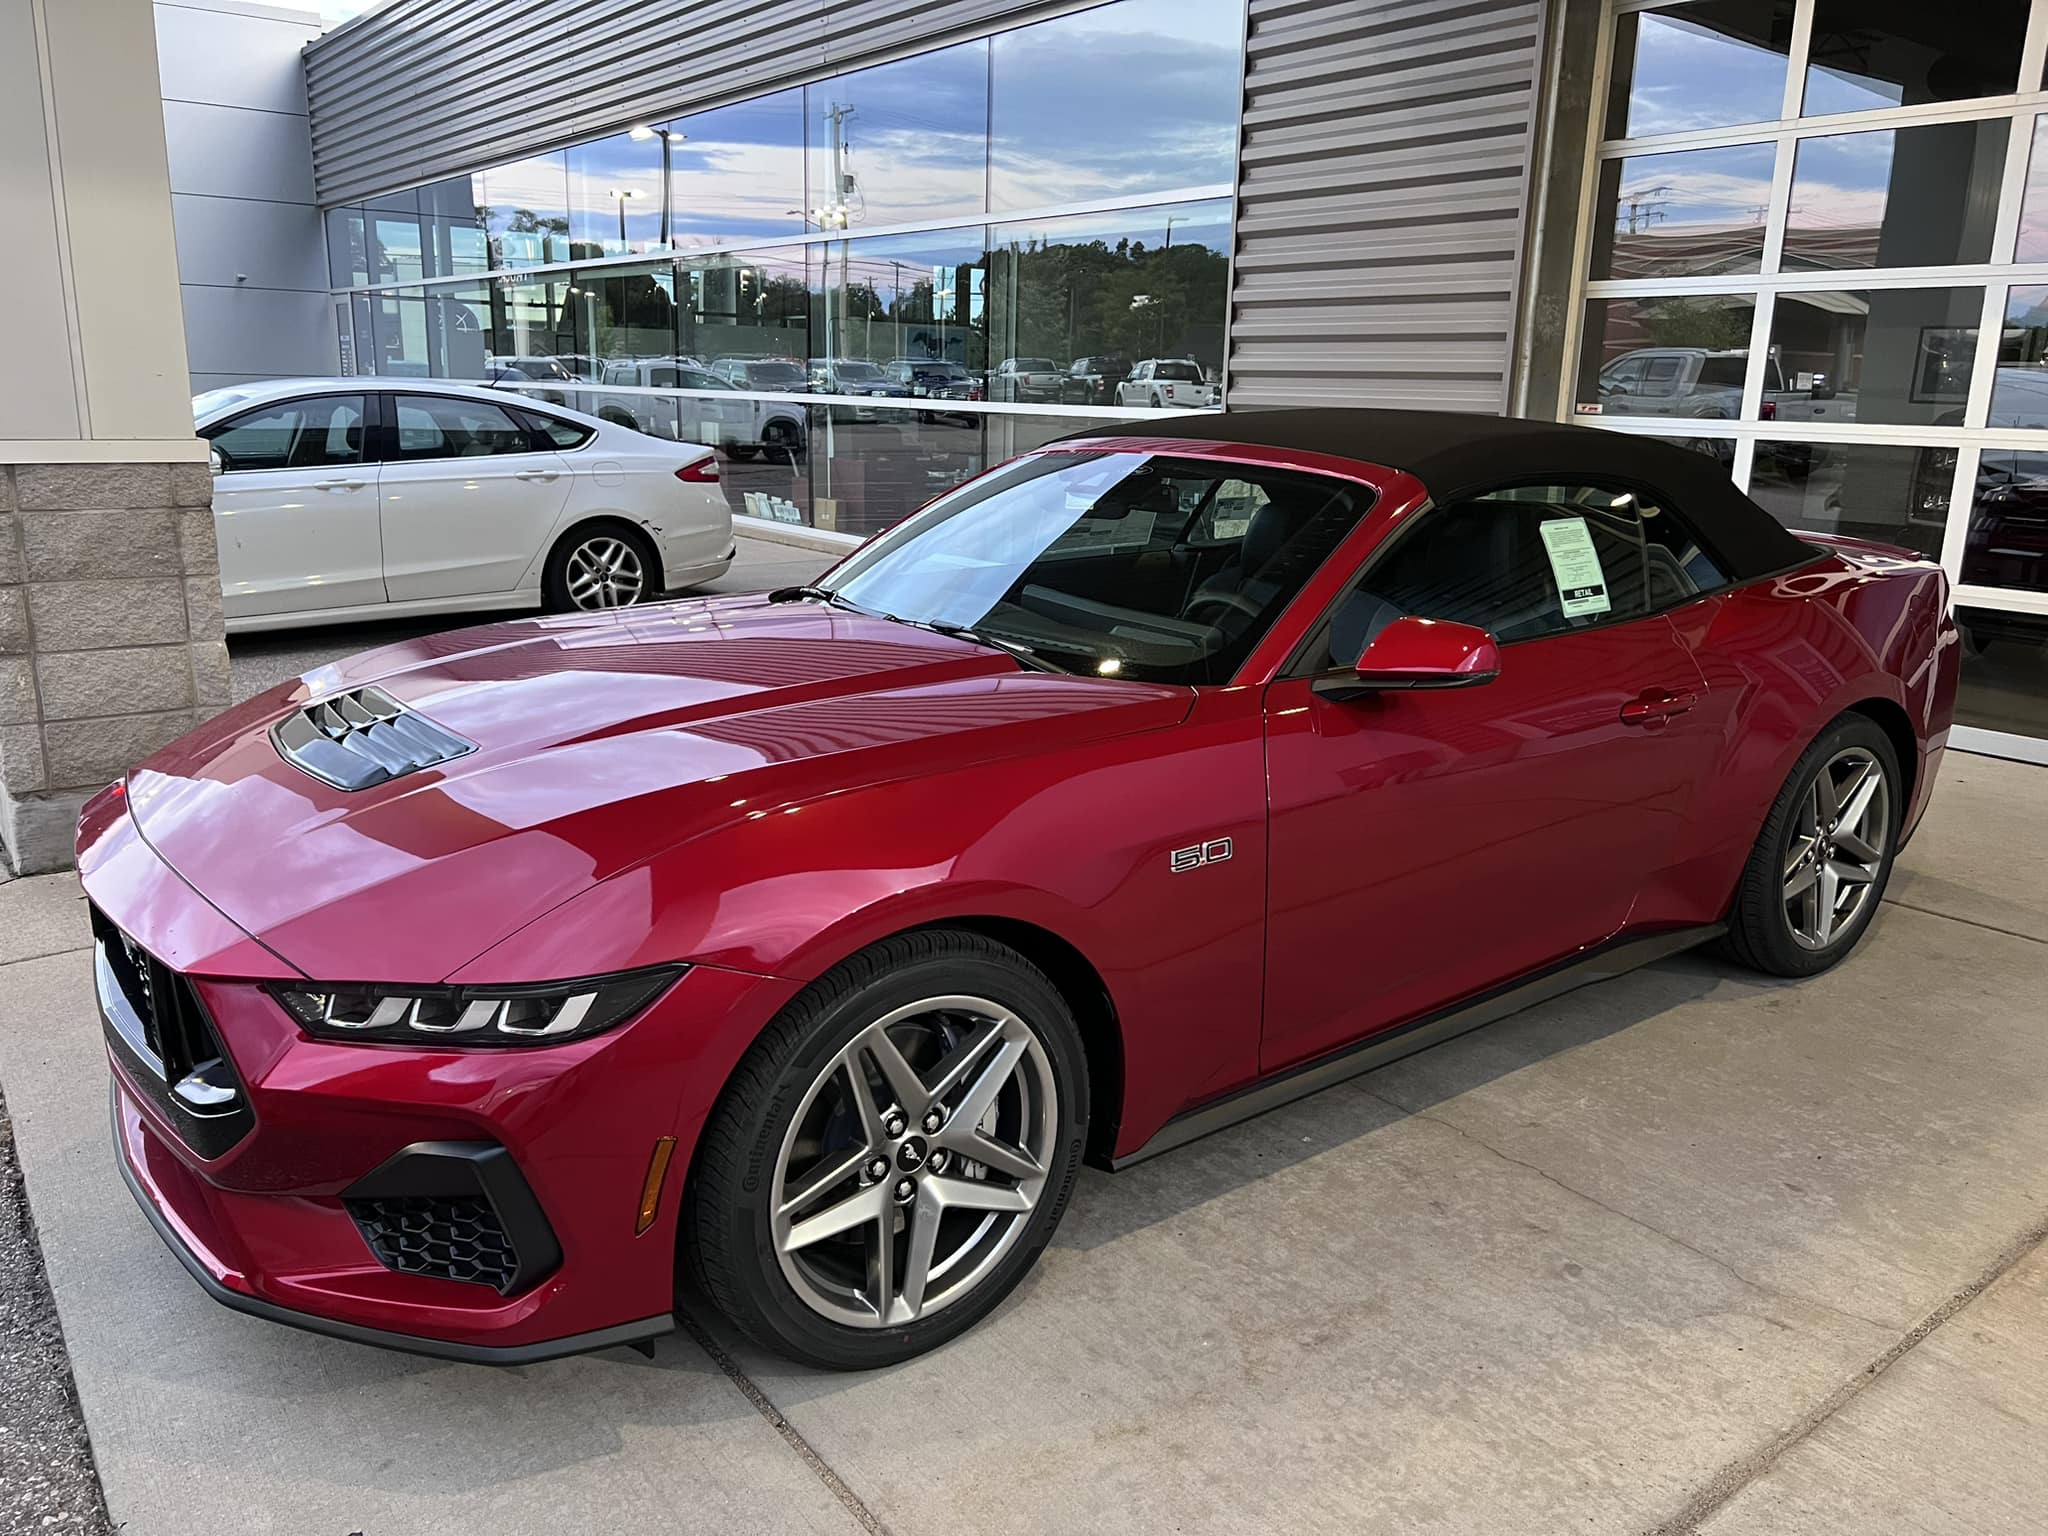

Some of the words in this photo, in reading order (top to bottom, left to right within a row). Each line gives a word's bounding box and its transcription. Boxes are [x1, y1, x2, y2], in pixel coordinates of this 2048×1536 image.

[1574, 588, 1594, 598] RETAIL
[1170, 836, 1233, 873] 5.0
[742, 1095, 785, 1192] Continental
[1049, 1138, 1081, 1221] Continental
